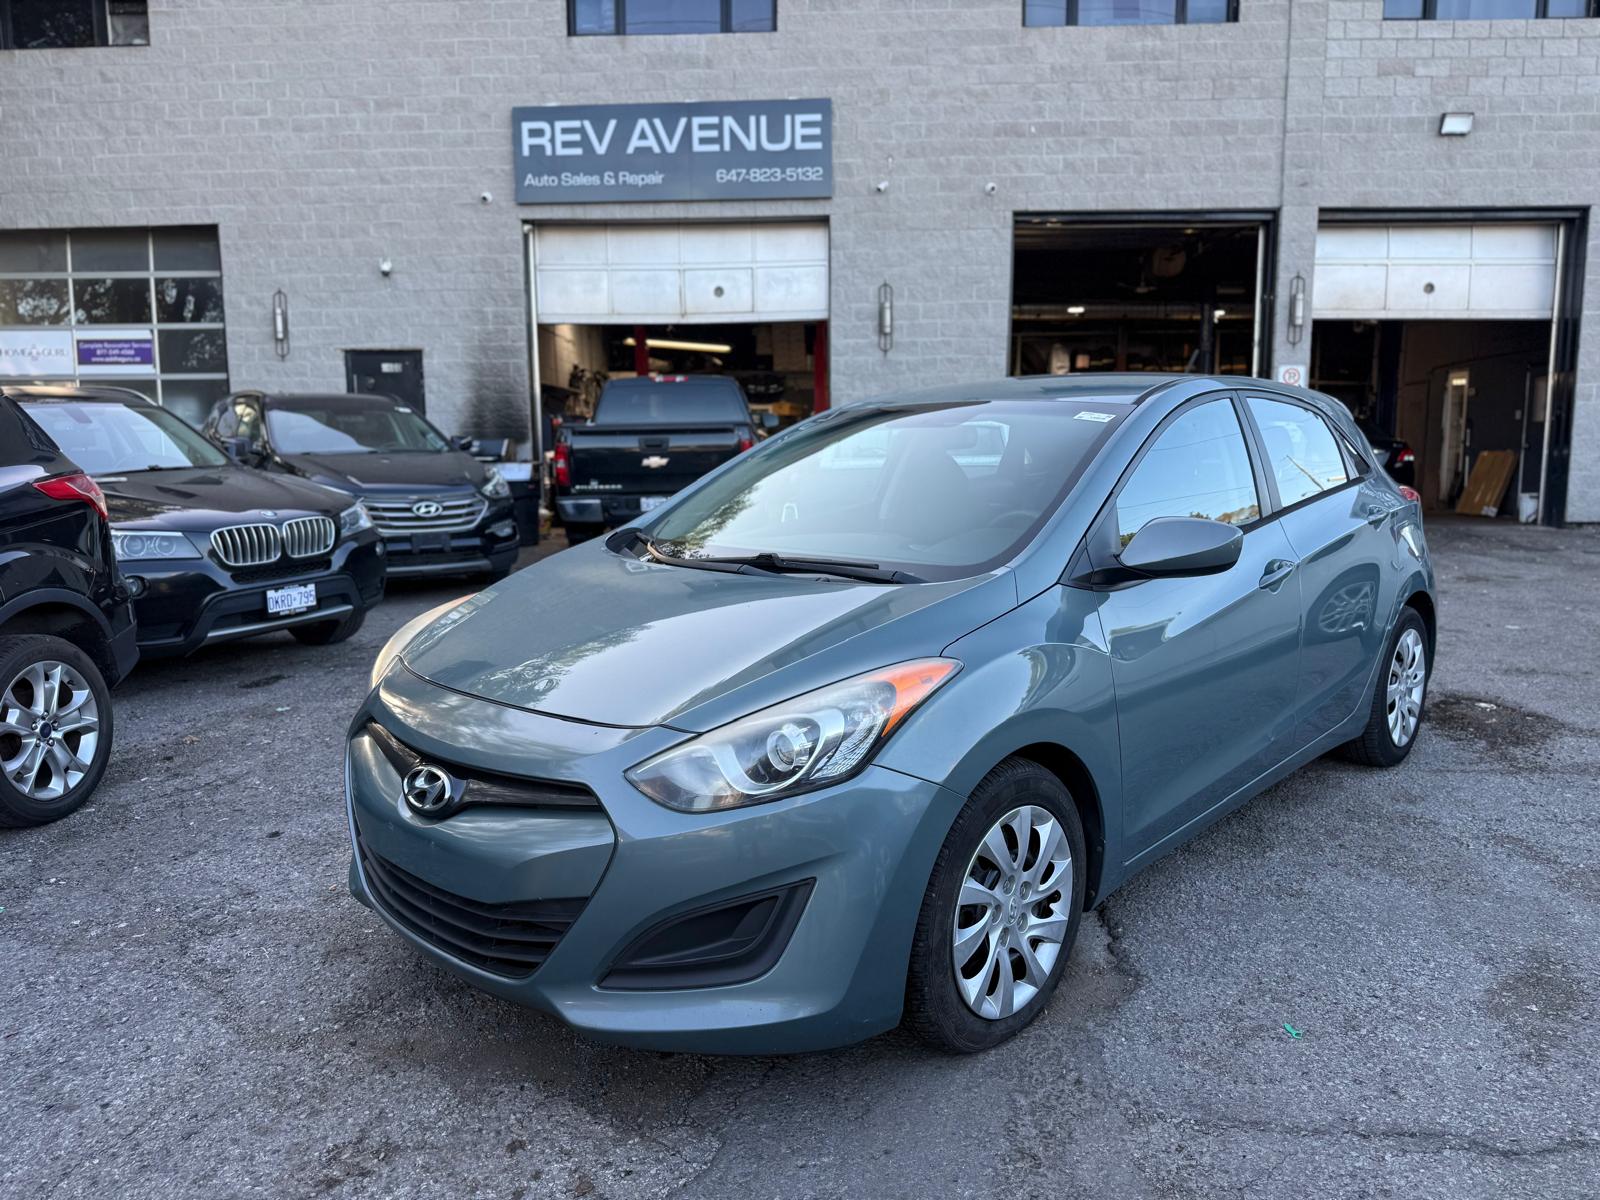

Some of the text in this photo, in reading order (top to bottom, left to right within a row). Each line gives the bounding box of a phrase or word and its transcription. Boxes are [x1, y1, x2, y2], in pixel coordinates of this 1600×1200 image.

[521, 113, 824, 157] REV AVENUE
[524, 170, 665, 188] Auto Sales & Repair
[716, 166, 824, 183] 647-823-5132
